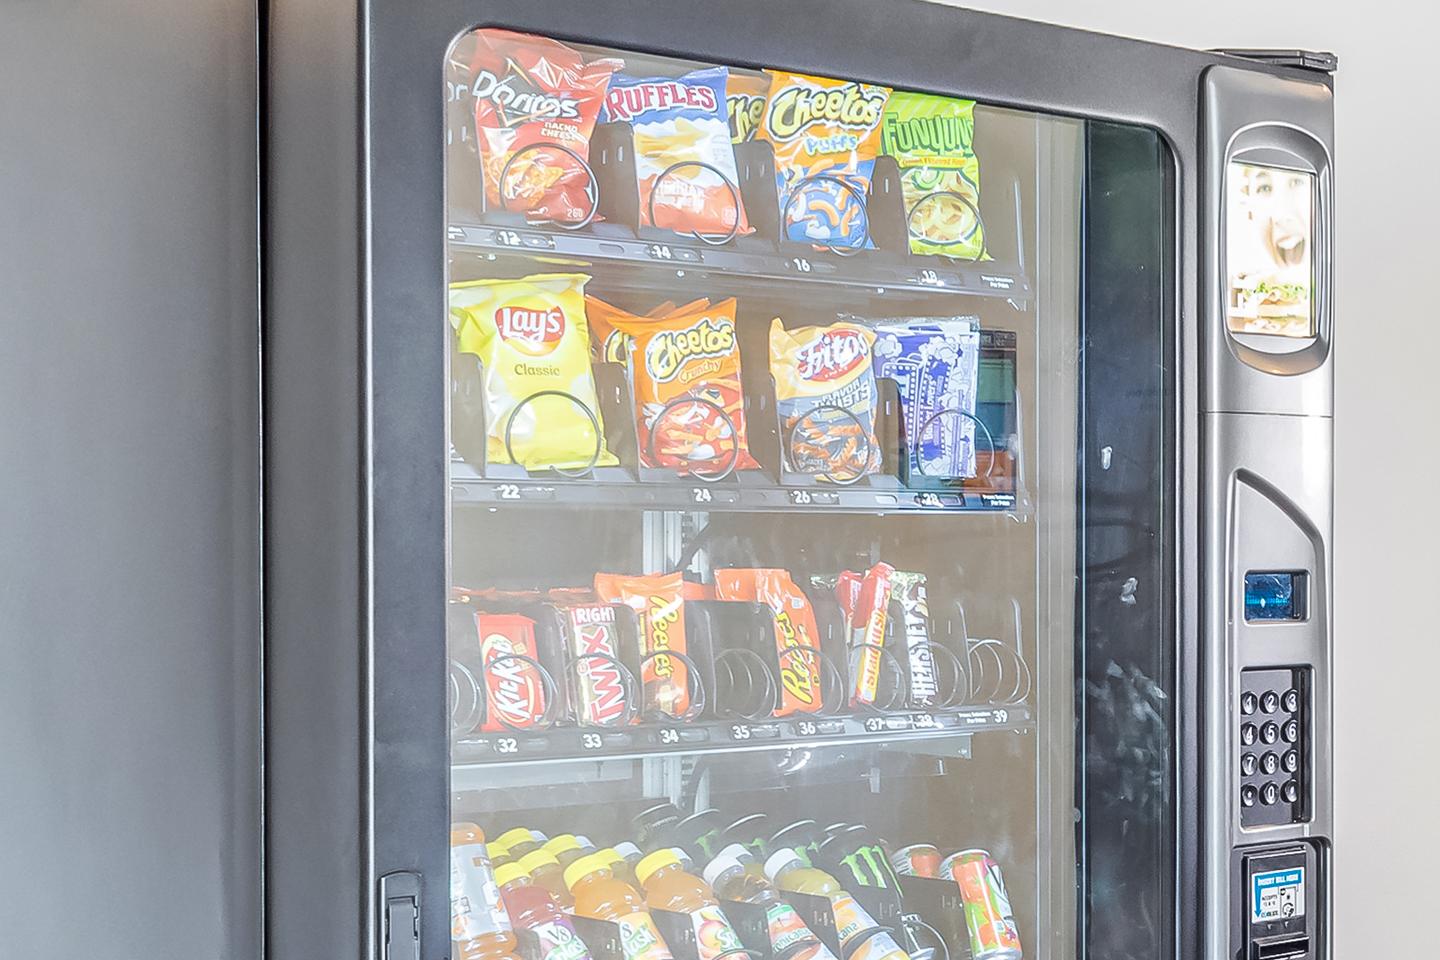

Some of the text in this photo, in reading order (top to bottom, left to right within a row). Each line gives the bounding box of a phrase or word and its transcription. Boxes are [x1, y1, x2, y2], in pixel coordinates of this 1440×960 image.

[472, 70, 578, 118] Doritos
[605, 83, 716, 122] RUFFLES
[770, 85, 884, 138] Cheetos
[499, 232, 521, 246] 12
[794, 257, 810, 272] 16
[502, 308, 562, 342] Lay's
[650, 320, 737, 380] Cheetos
[796, 333, 868, 380] Fritos
[514, 363, 560, 377] Classic
[679, 360, 724, 384] Crunchy
[501, 485, 520, 498] 22
[693, 489, 712, 502] 24
[793, 491, 811, 504] 26
[649, 595, 679, 678] Reese's
[582, 626, 627, 723] TWIX
[1268, 694, 1276, 706] 2
[1290, 693, 1297, 705] 3
[867, 717, 883, 731] 37
[993, 709, 1008, 724] 39
[733, 725, 750, 739] 35
[800, 721, 816, 735] 36
[1247, 723, 1297, 739] 4 5 6
[583, 734, 602, 748] 33
[660, 729, 679, 743] 34
[497, 738, 518, 753] 32
[1247, 753, 1296, 770] 7 8 9
[1268, 786, 1275, 799] 0
